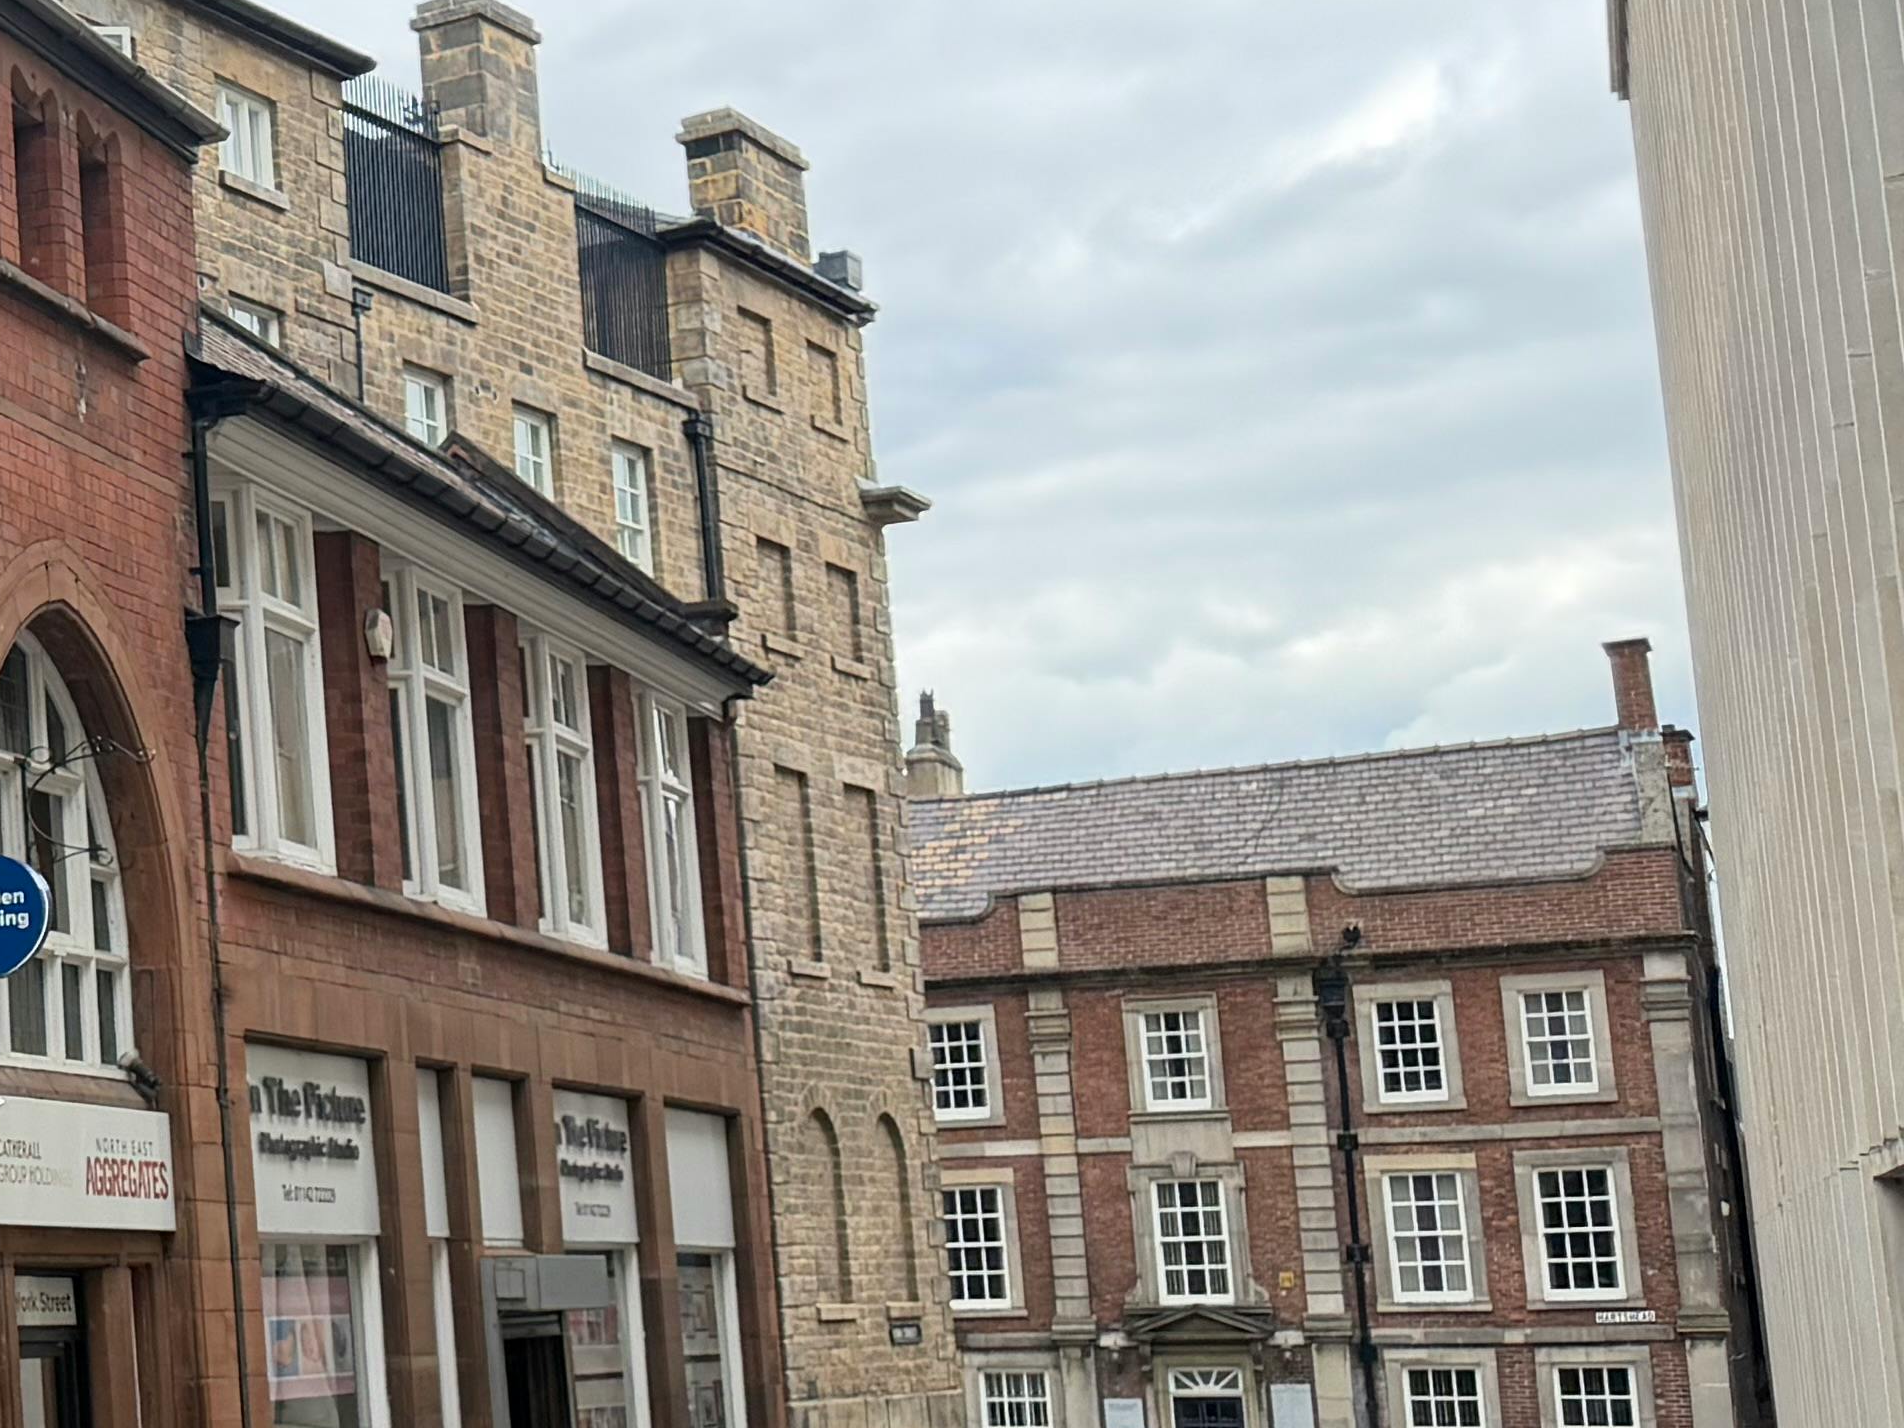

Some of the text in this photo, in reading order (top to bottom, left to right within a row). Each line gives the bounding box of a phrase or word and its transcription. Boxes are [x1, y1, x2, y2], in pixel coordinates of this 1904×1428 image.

[262, 1076, 302, 1119] The
[302, 1081, 367, 1124] Picture
[95, 1137, 154, 1157] NORTH EAST
[86, 1156, 170, 1201] AGGREGATES
[40, 1292, 72, 1313] Street
